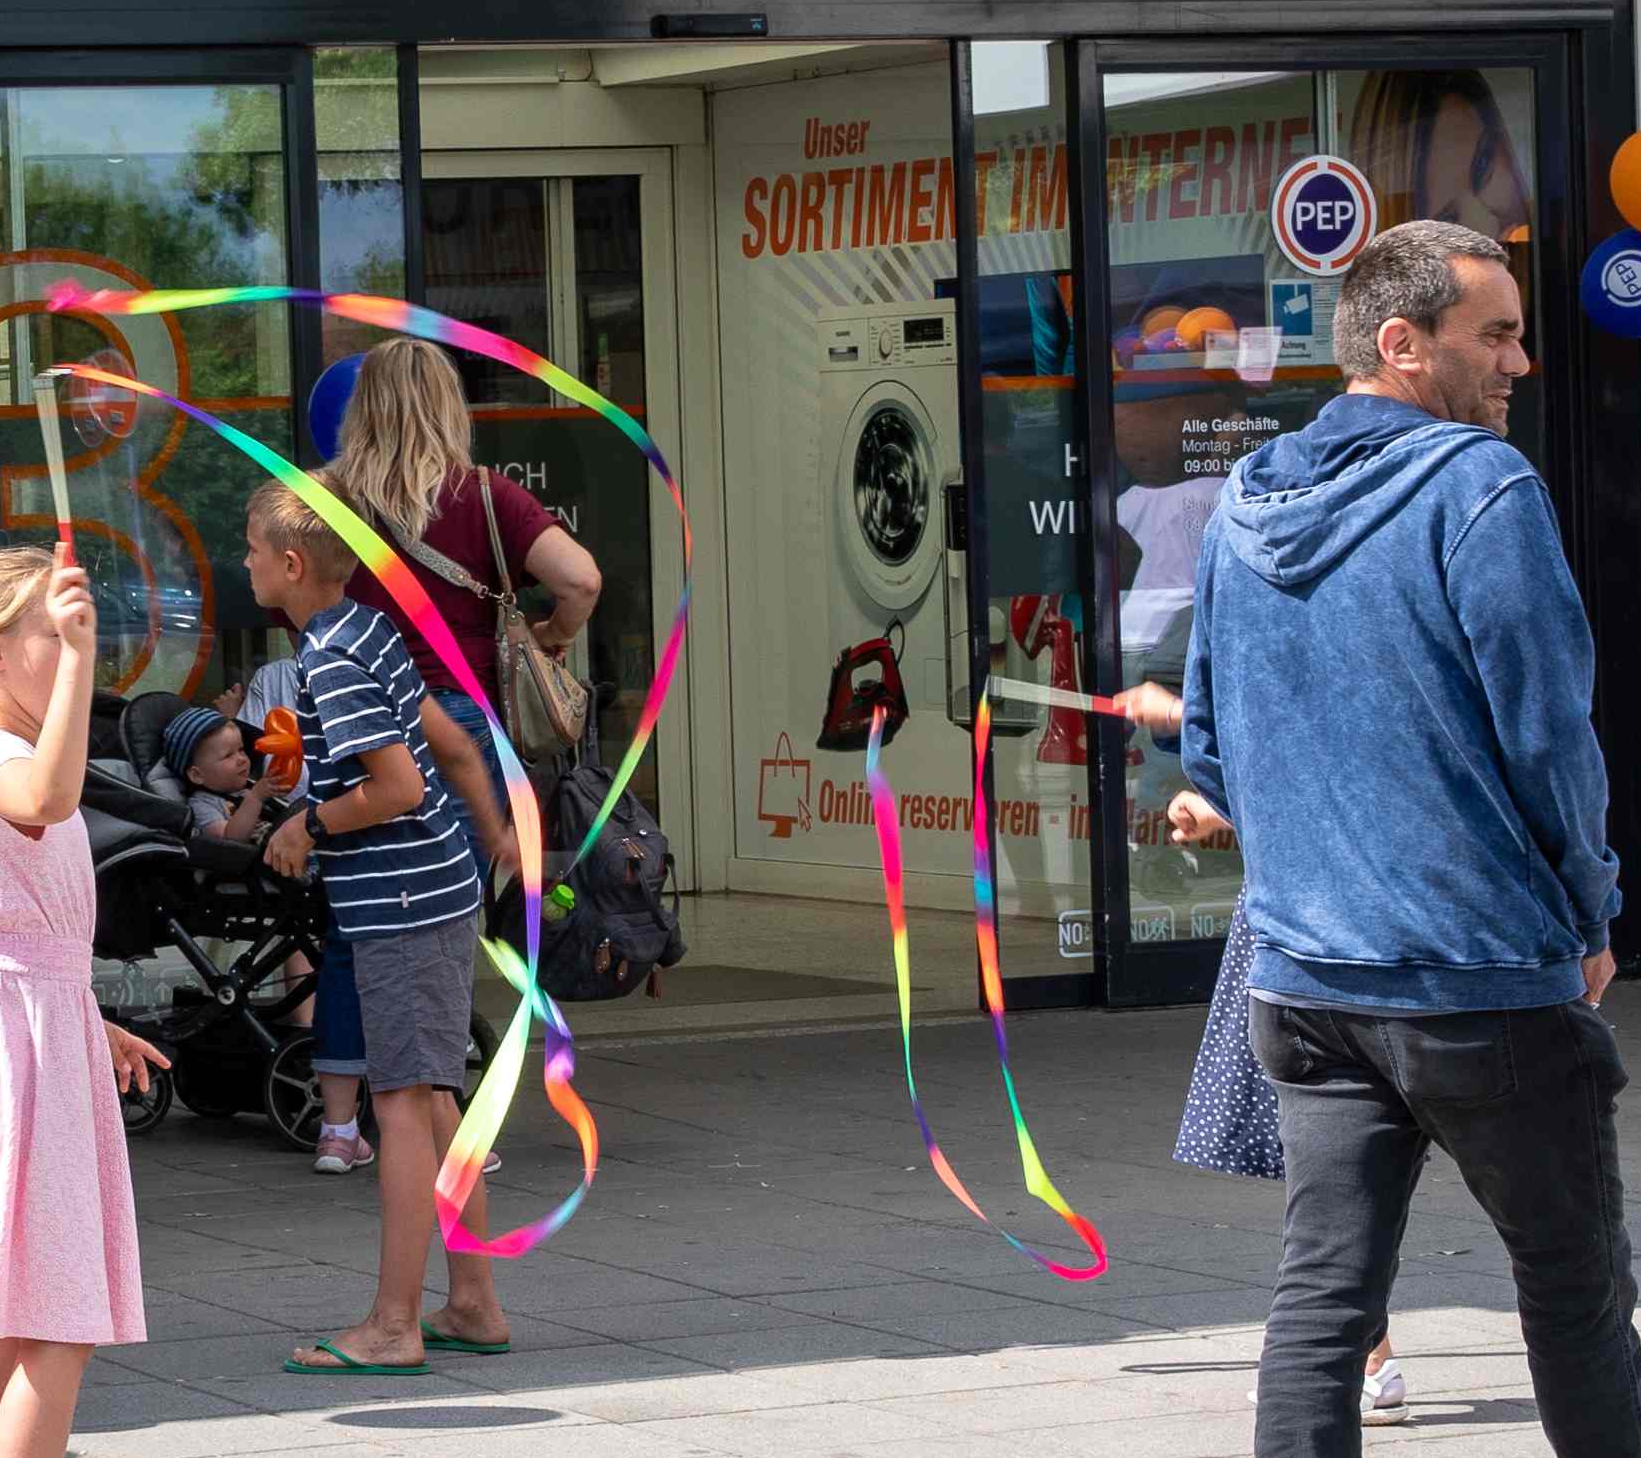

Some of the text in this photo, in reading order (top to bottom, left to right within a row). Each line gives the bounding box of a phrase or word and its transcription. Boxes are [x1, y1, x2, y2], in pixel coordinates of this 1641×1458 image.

[804, 117, 870, 159] Unser
[1107, 114, 1342, 225] NTERNE
[1295, 200, 1355, 232] PEP
[1182, 417, 1279, 433] Alle Geschäfte
[1182, 439, 1231, 454] Montag
[1184, 460, 1220, 473] 09:00
